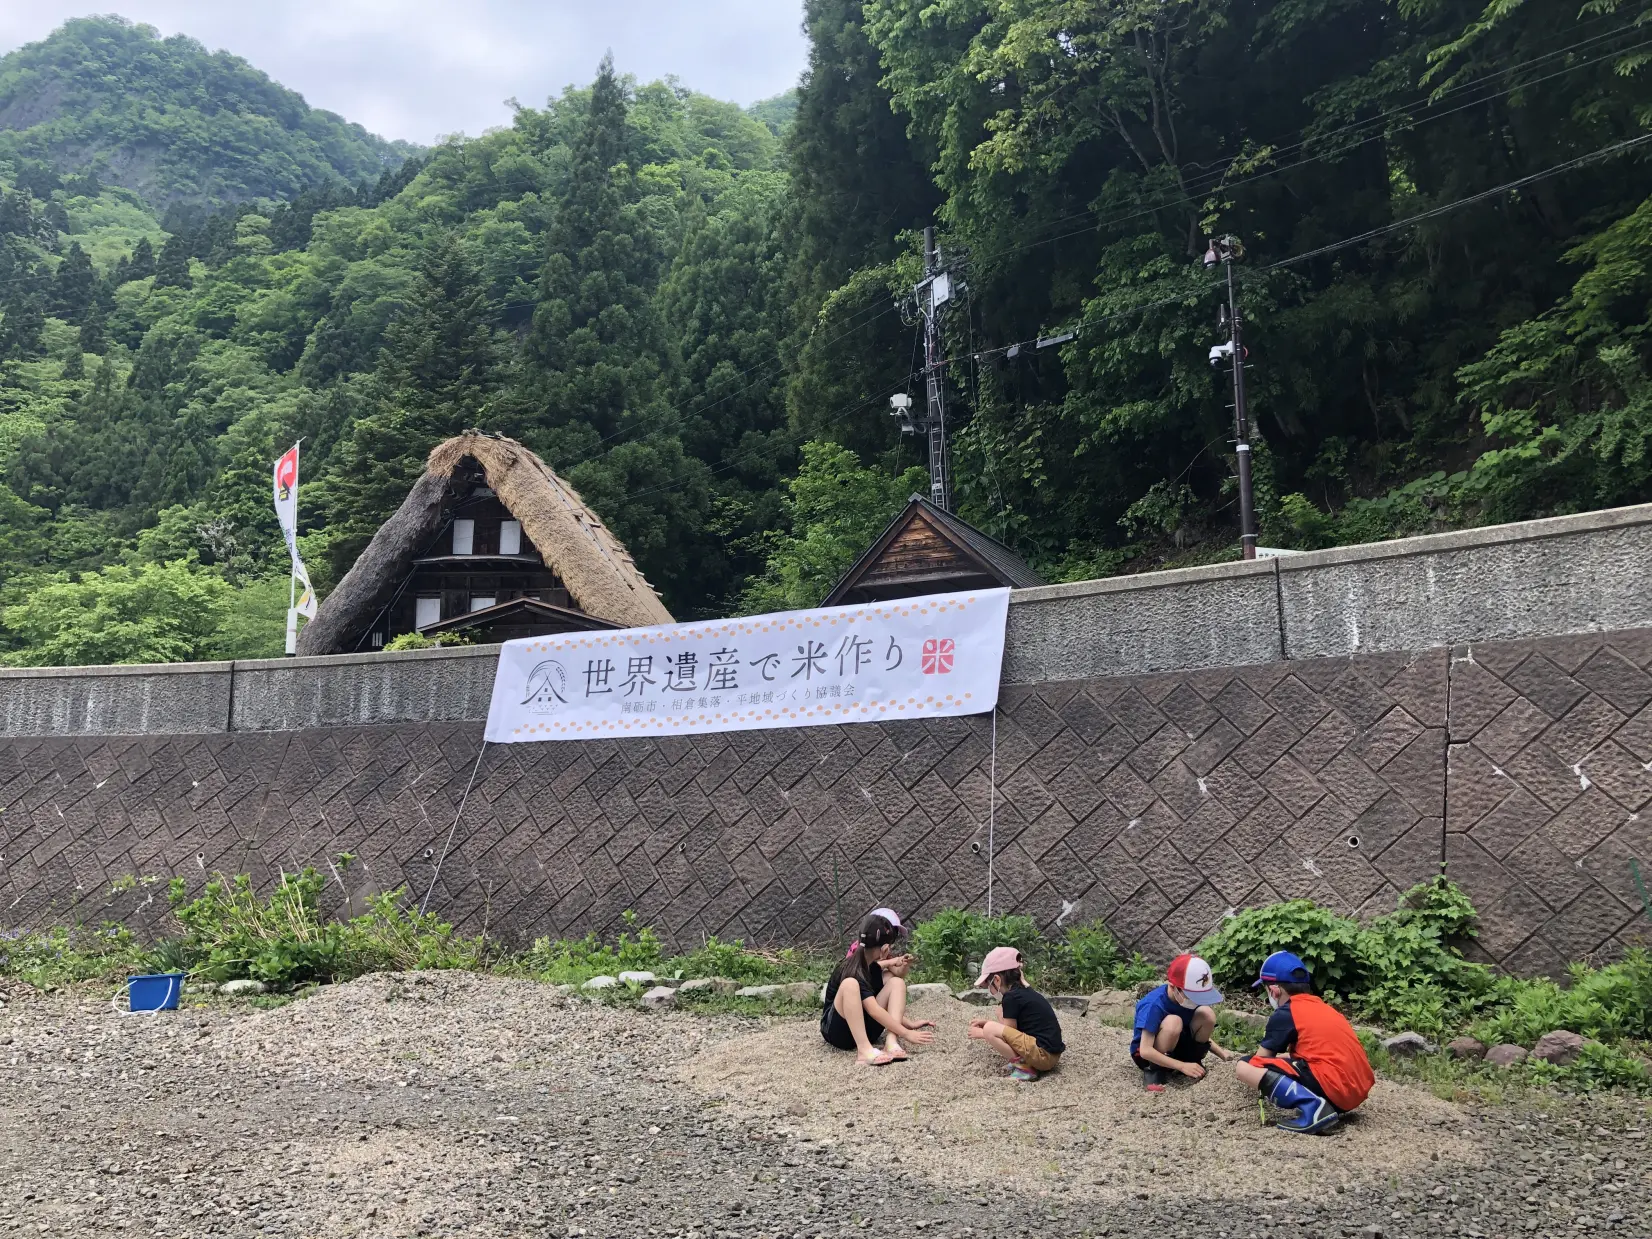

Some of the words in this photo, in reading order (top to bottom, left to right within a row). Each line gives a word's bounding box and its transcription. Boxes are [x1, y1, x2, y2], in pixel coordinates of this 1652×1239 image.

[582, 635, 903, 697] 世界遺産で米作り
[922, 638, 955, 674] 米
